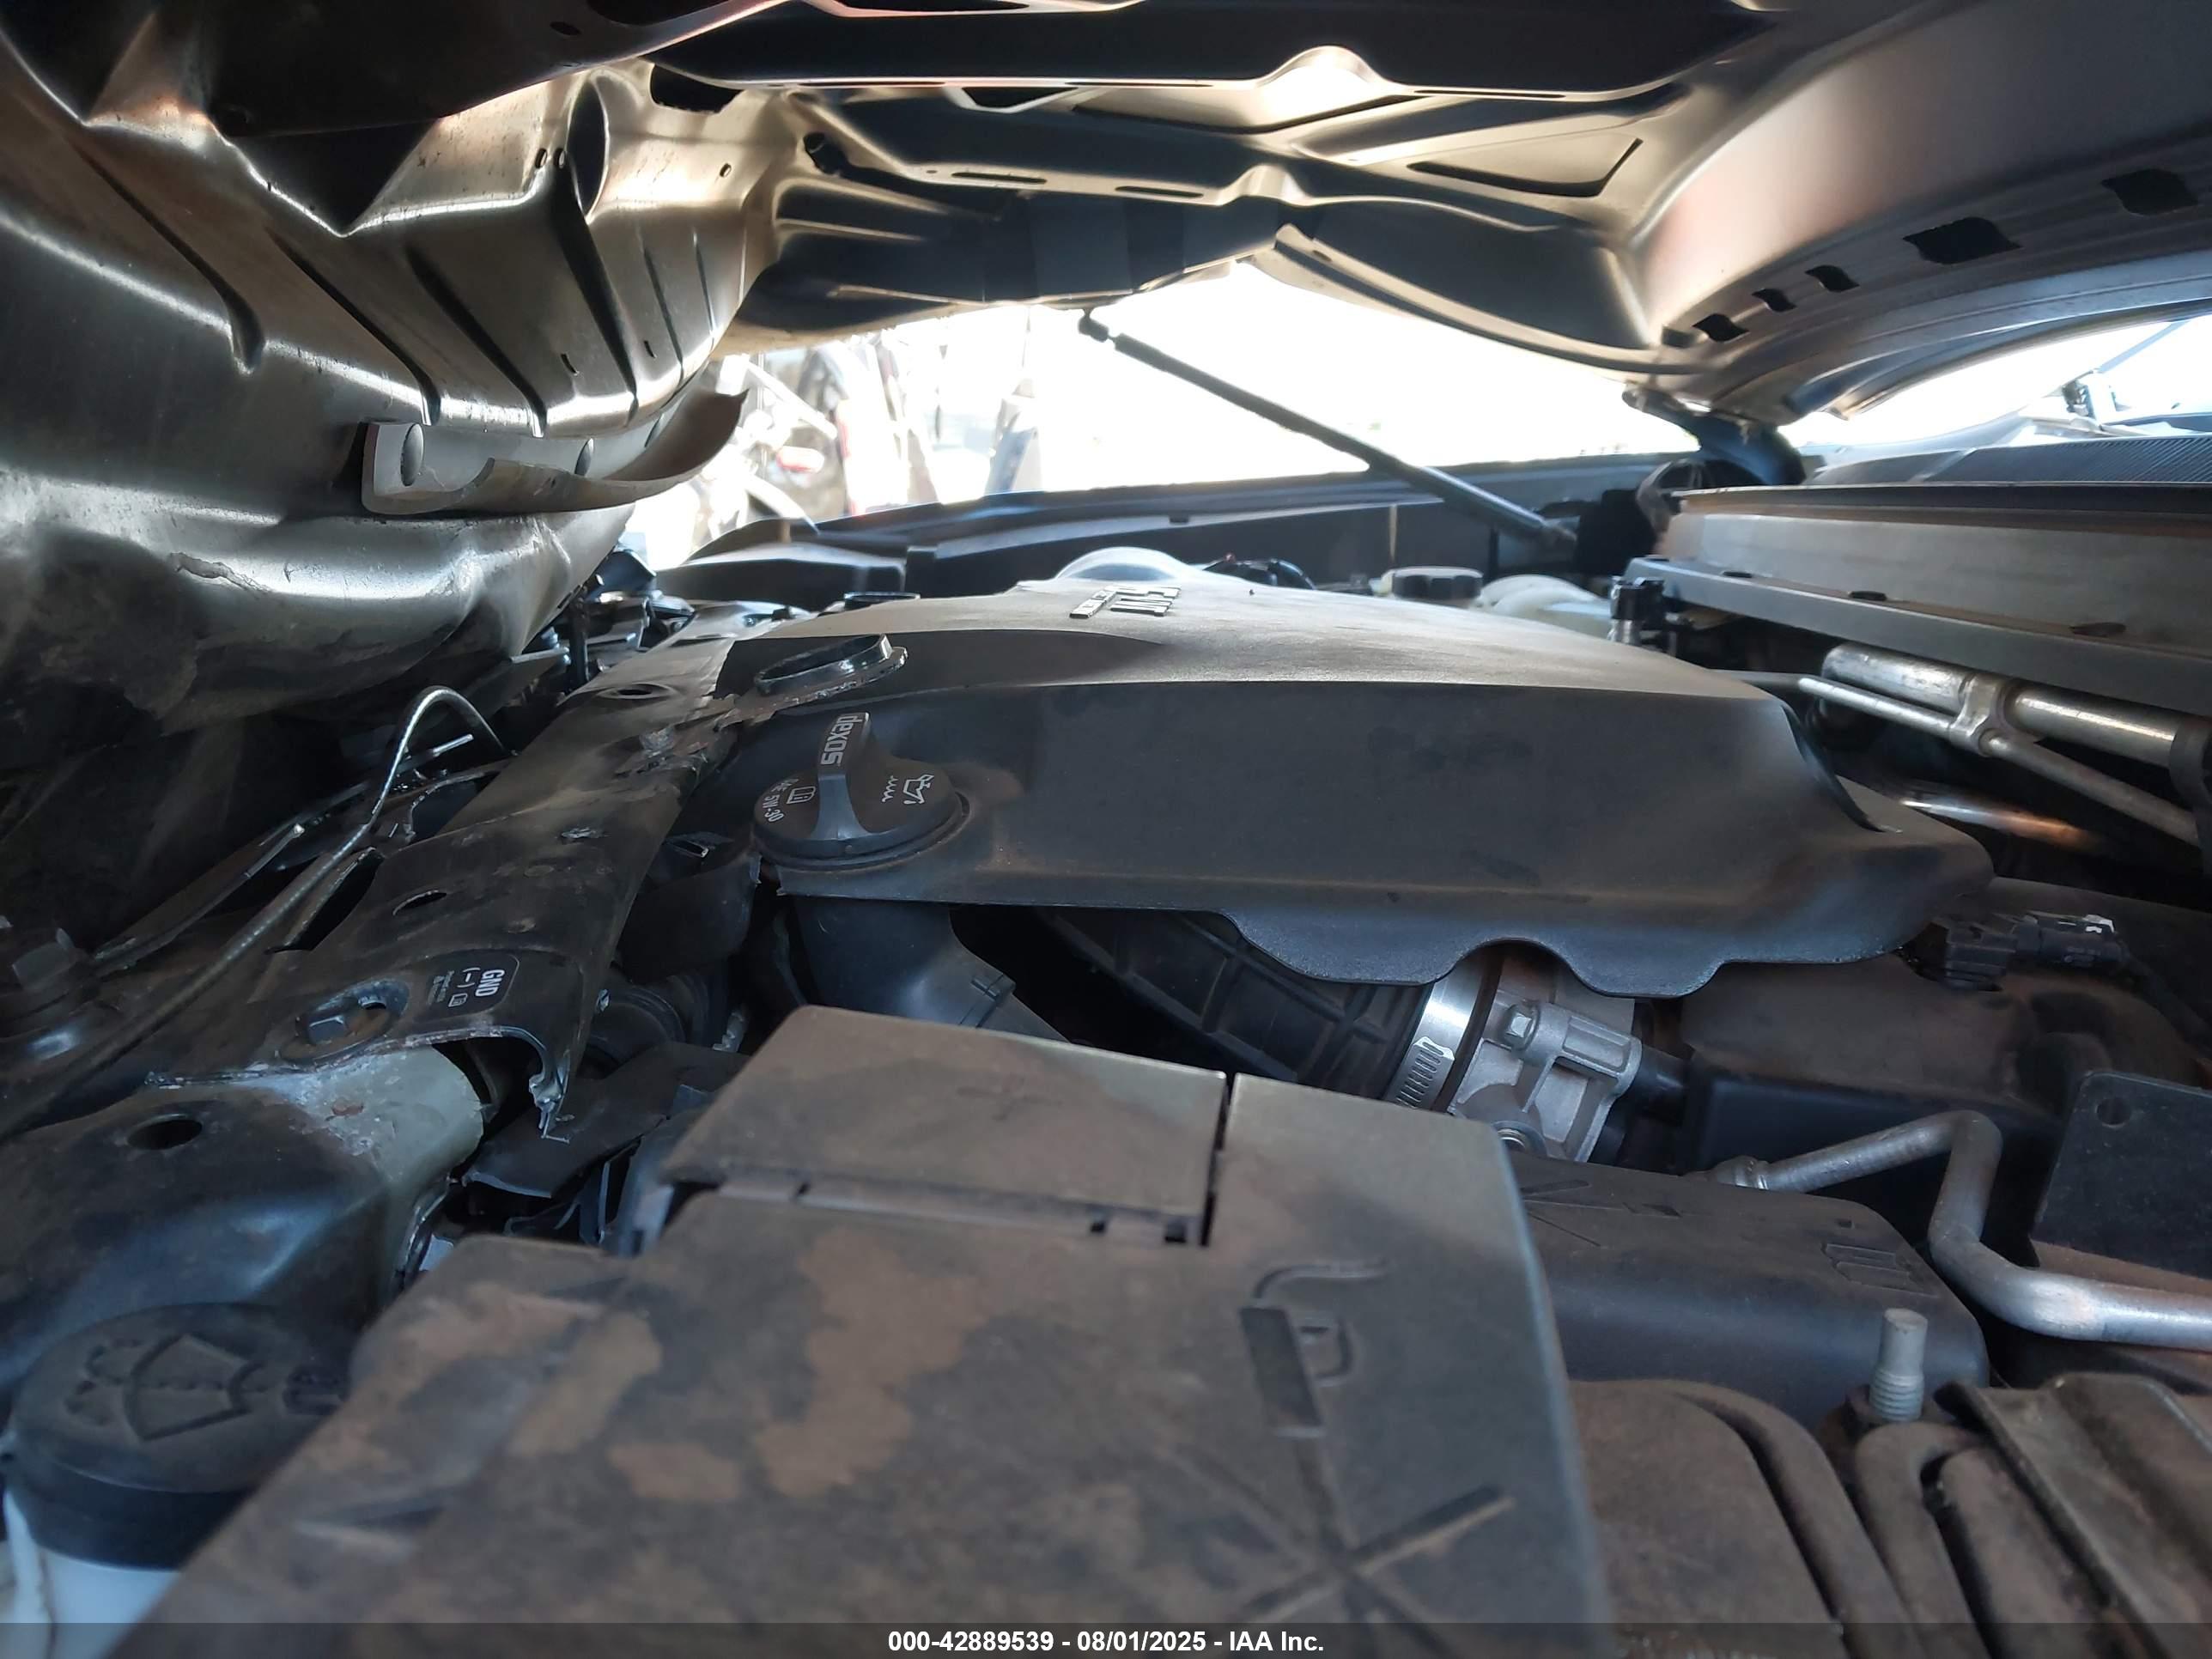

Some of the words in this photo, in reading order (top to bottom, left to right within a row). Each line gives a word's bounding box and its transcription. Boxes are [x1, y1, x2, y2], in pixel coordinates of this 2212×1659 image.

[820, 714, 864, 766] dexos
[762, 793, 786, 823] 5W-30
[474, 969, 506, 997] GND
